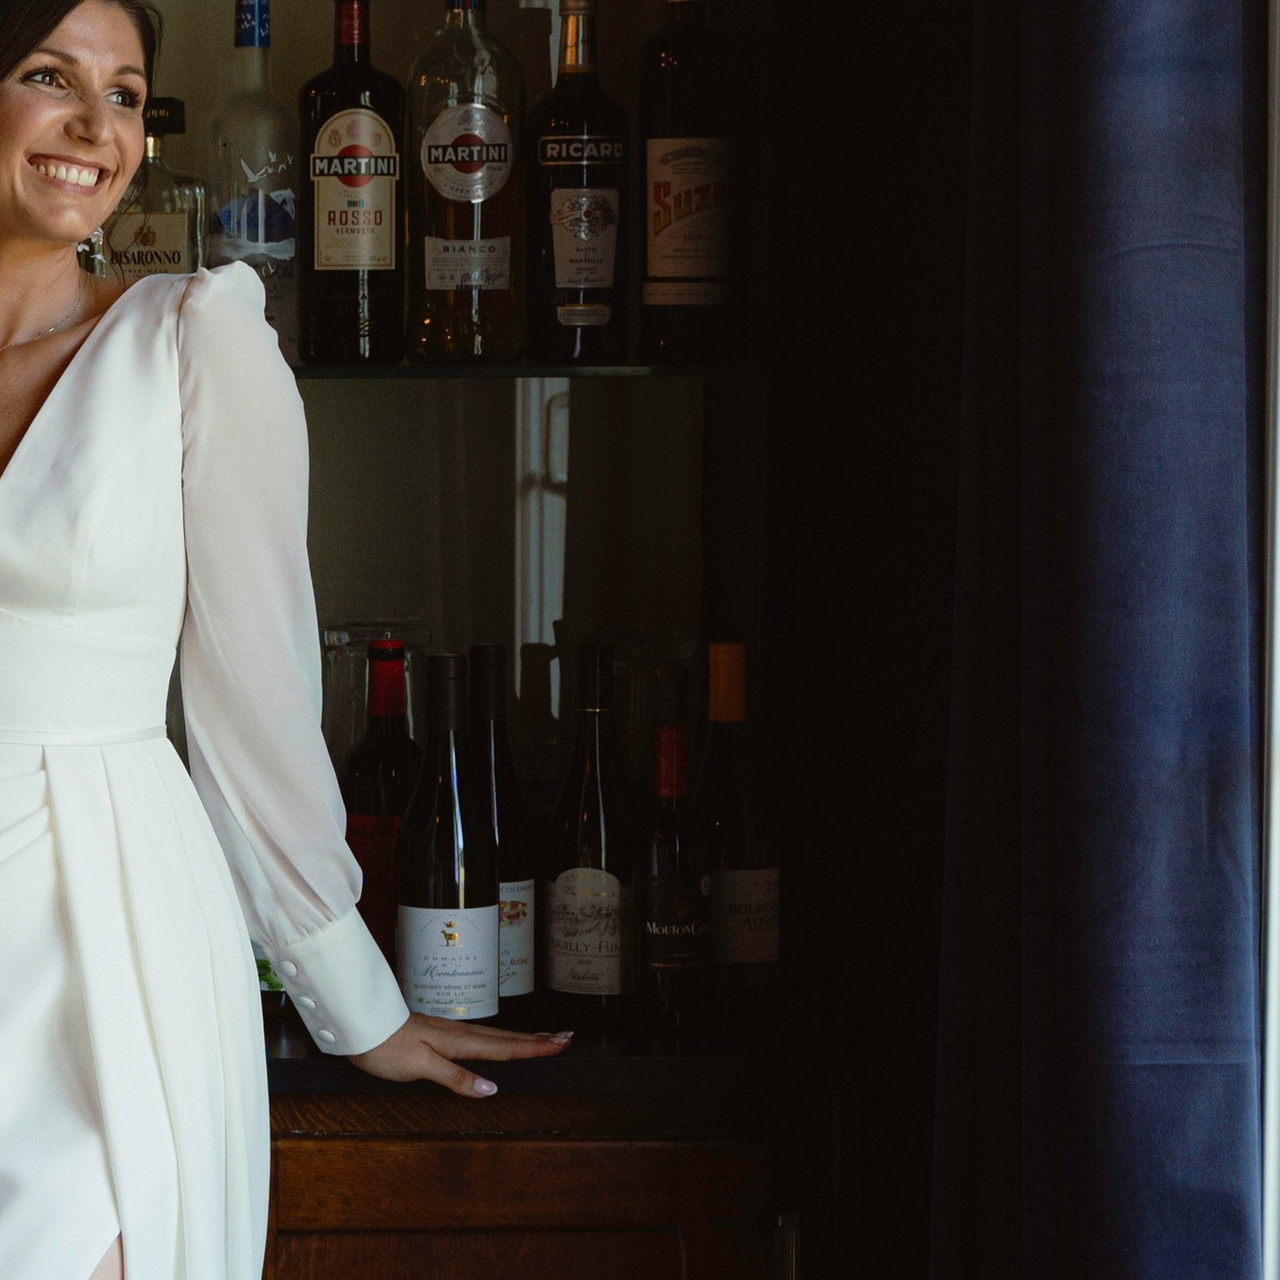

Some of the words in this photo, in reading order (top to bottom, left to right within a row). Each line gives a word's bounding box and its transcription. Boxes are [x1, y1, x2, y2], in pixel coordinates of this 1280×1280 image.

[430, 146, 506, 163] MARTINI
[546, 143, 623, 158] RICARD
[314, 157, 394, 175] MARTINI
[328, 210, 383, 226] ROSSO
[443, 245, 496, 253] BIANCO
[110, 251, 180, 265] DISARONNO
[646, 921, 690, 935] MOUTON
